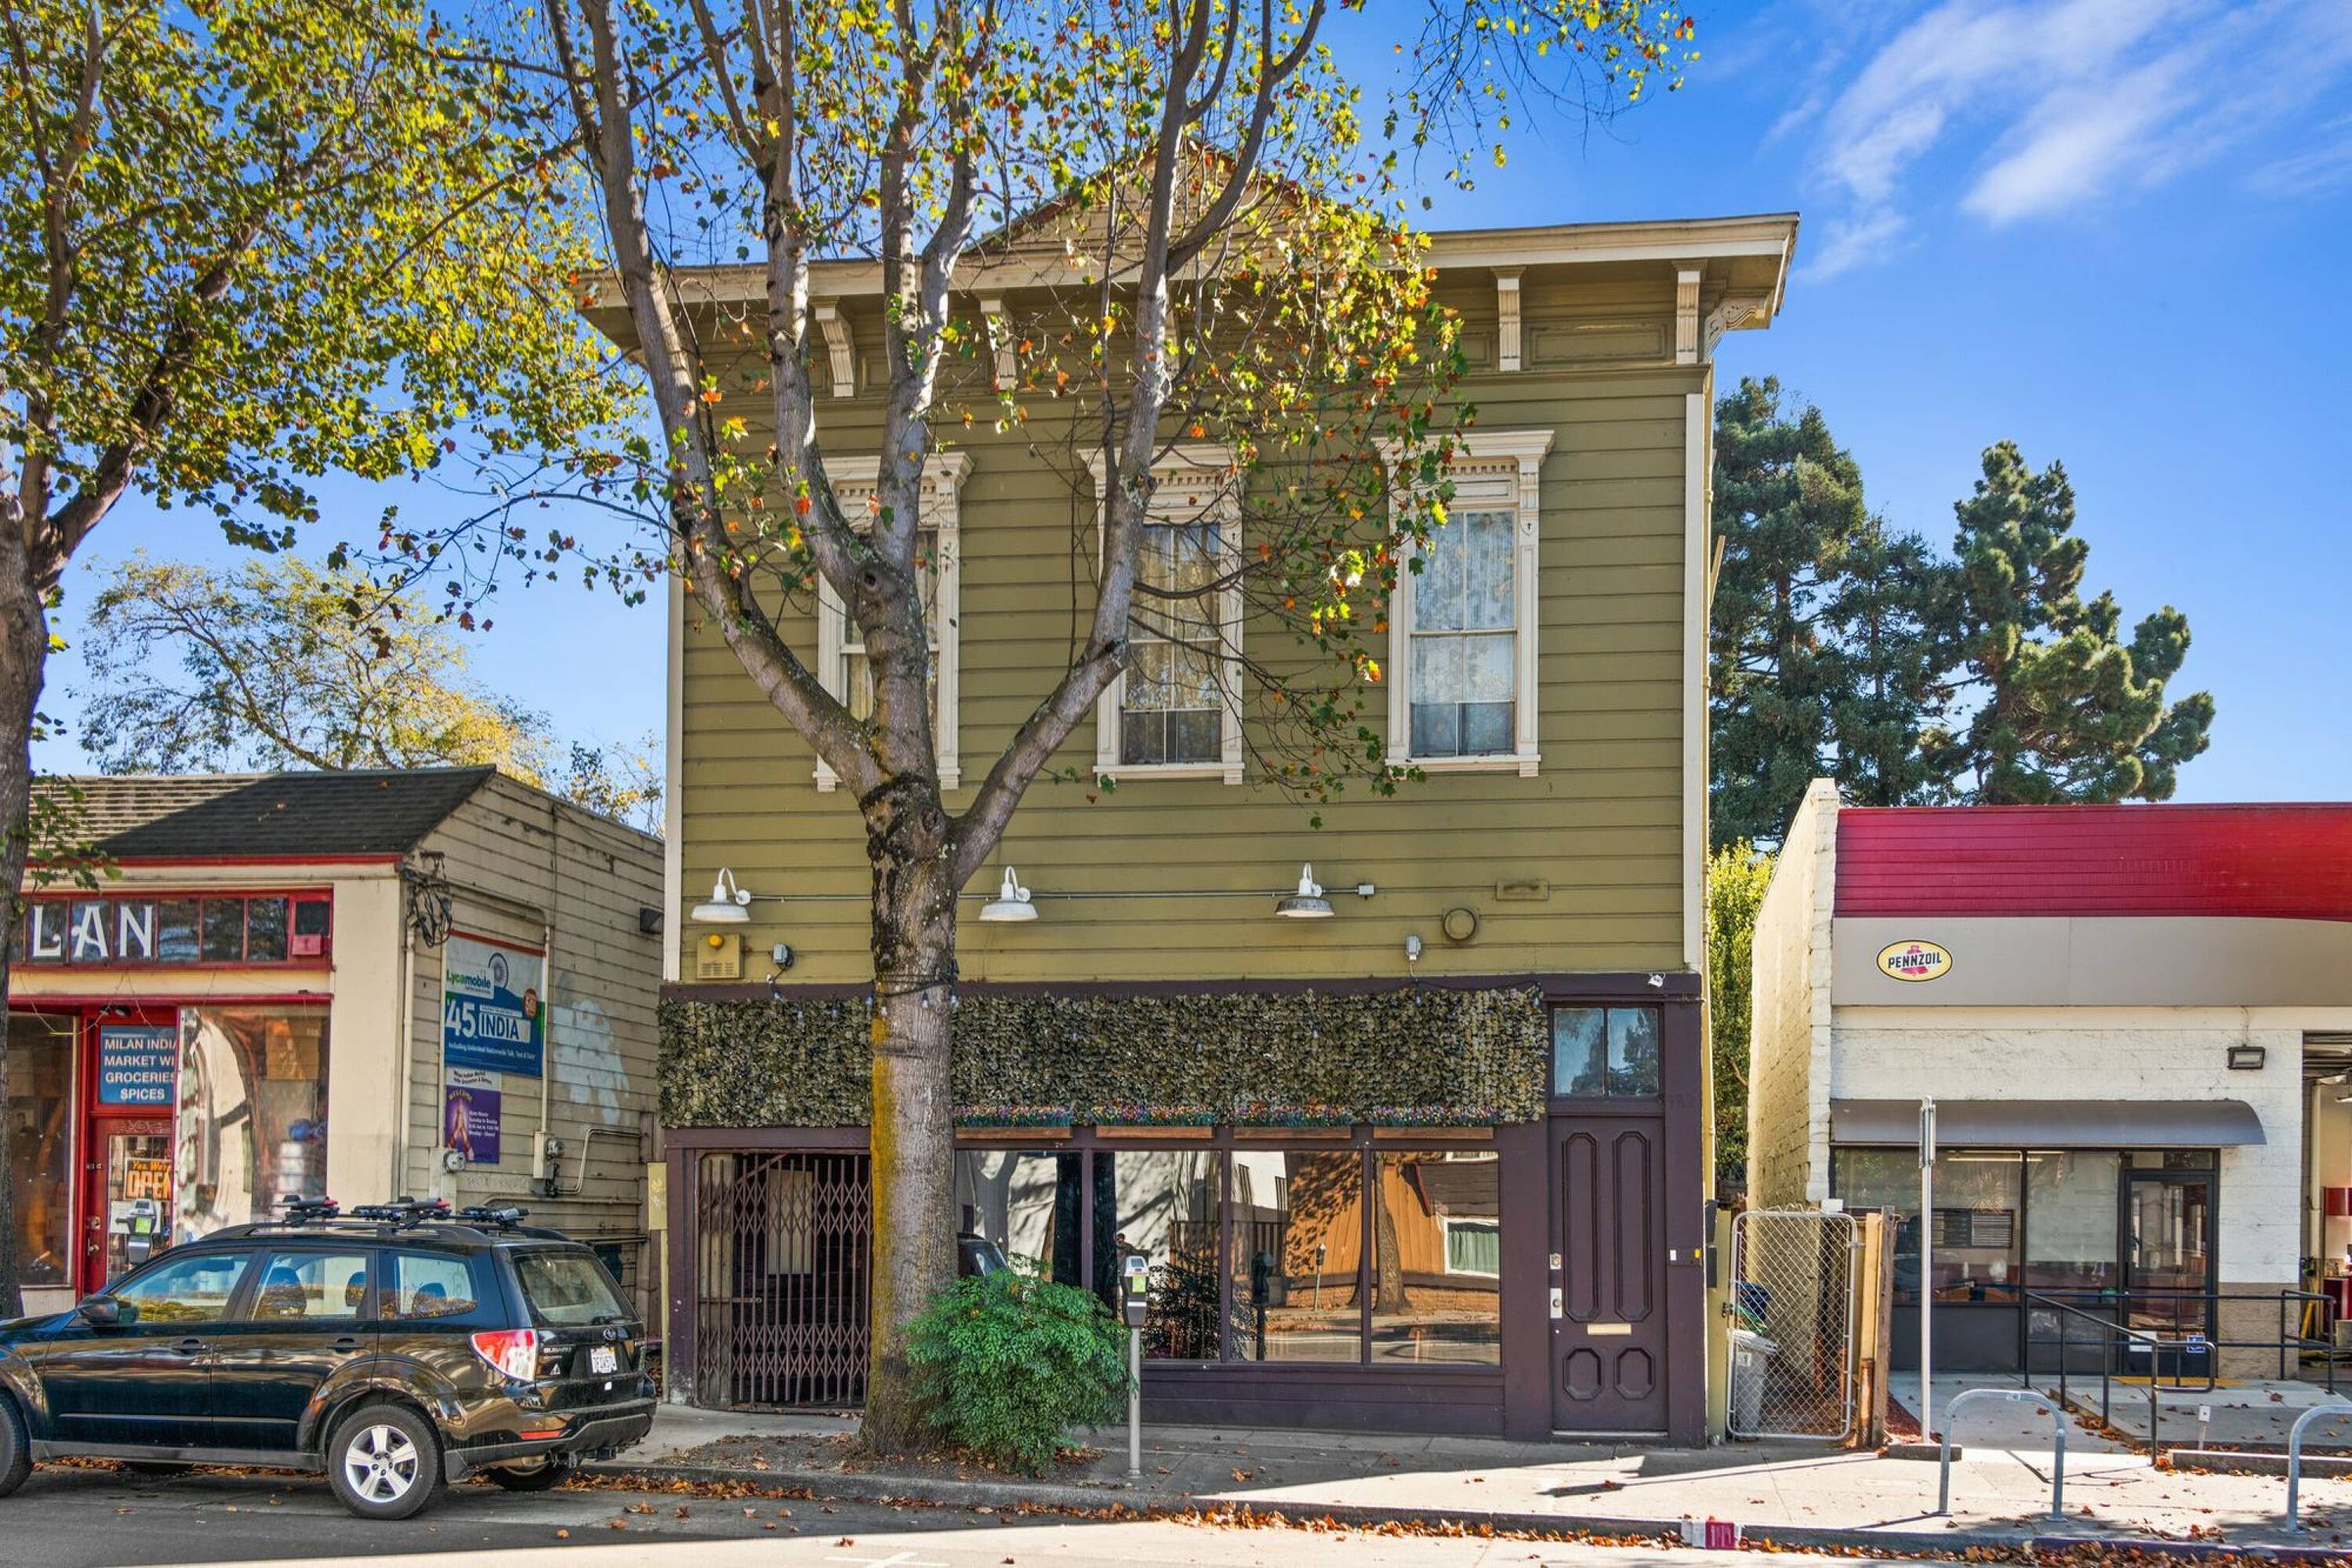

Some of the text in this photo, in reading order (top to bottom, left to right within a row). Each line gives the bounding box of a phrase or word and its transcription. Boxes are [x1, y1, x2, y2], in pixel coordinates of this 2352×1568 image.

[1888, 952, 1942, 969] PENNZOIL
[481, 1012, 520, 1040] INDIA
[105, 1039, 143, 1049] MILAN
[104, 1055, 157, 1066] MARKET
[120, 1088, 165, 1100] SPICES
